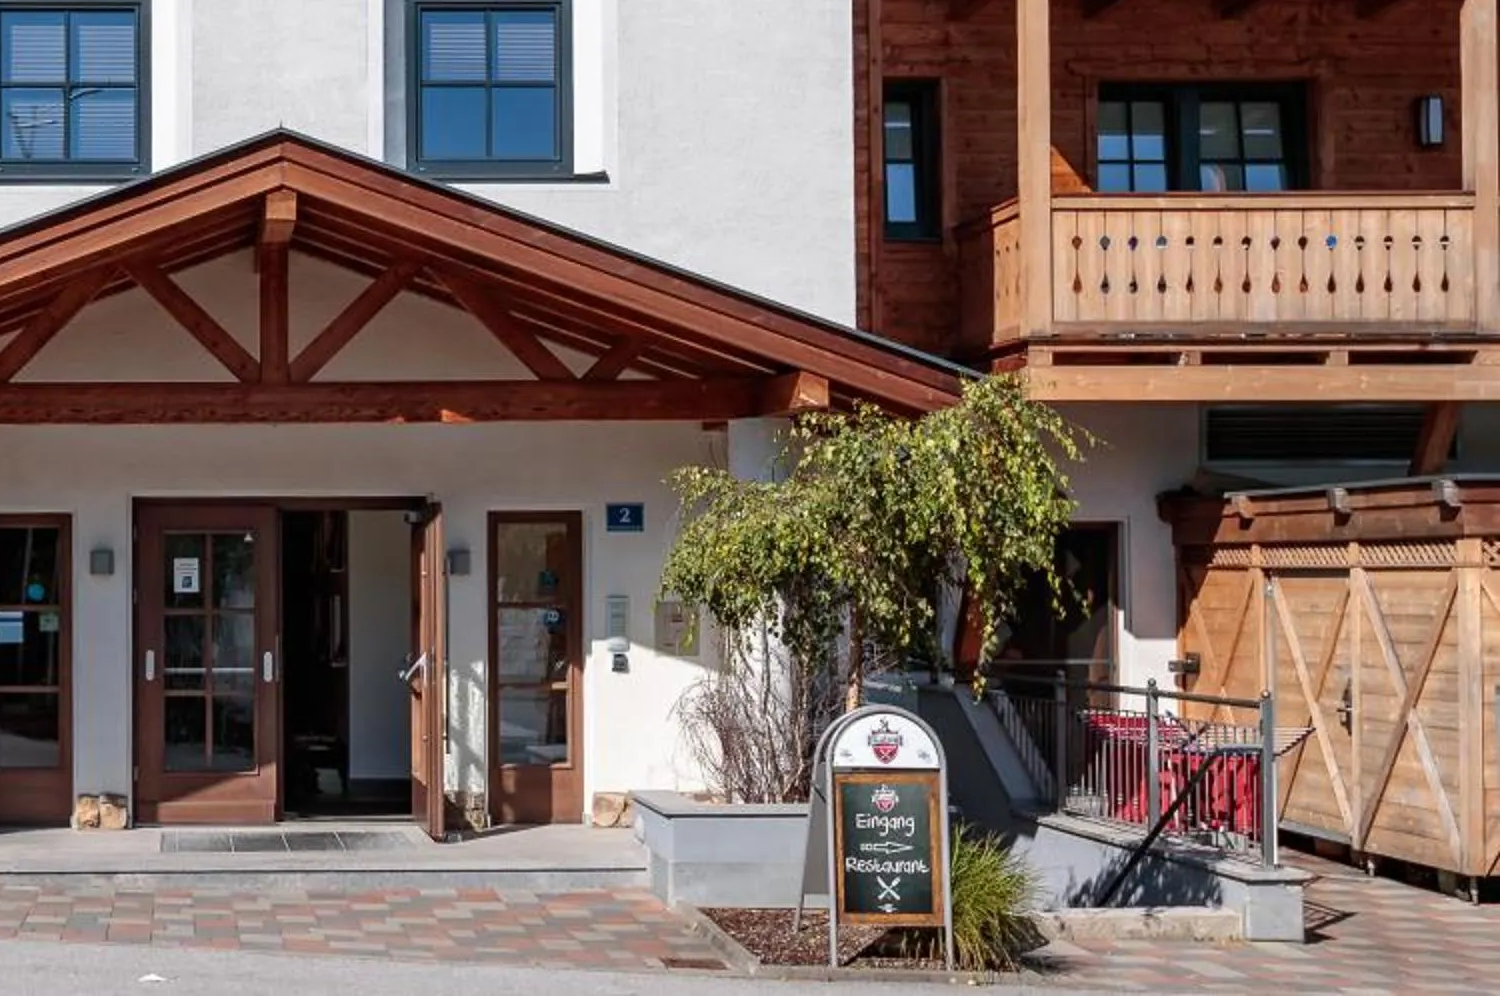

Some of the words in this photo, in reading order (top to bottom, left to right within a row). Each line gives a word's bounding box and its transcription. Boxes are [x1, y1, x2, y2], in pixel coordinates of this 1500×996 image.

[620, 507, 631, 523] 2
[855, 813, 915, 837] Eingang
[845, 857, 930, 874] Restaurant
